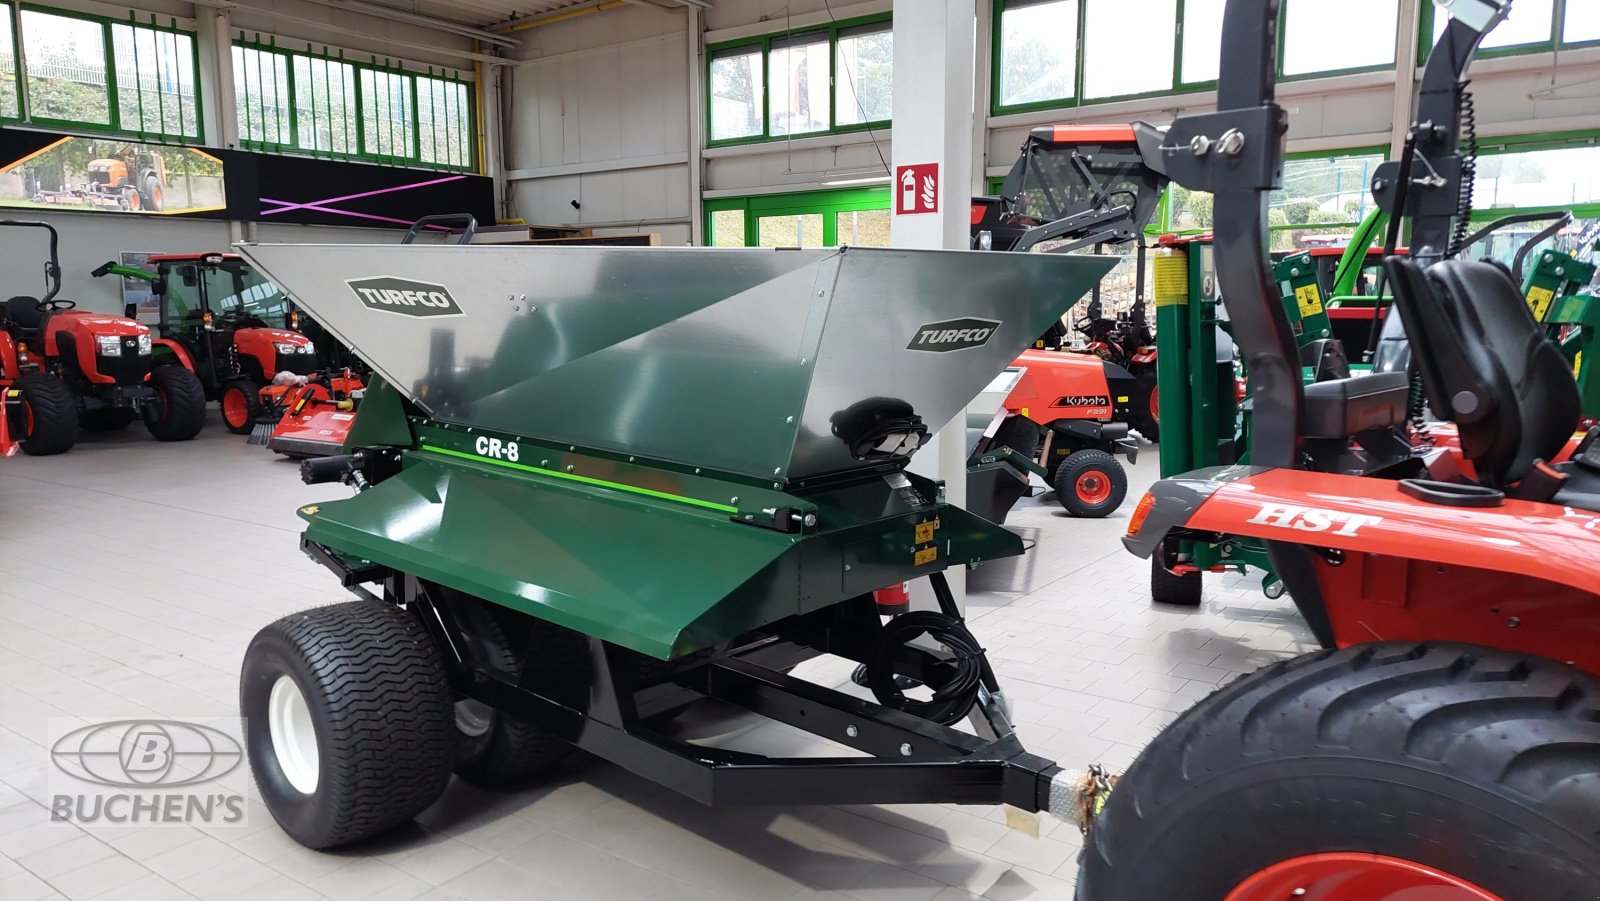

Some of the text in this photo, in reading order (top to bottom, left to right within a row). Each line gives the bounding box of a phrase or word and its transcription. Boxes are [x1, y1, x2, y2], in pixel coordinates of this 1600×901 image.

[357, 287, 450, 308] TURFCO
[918, 327, 992, 344] TURFCO
[1066, 395, 1106, 406] Kubota
[475, 435, 519, 462] CR-8
[1247, 501, 1384, 537] HST
